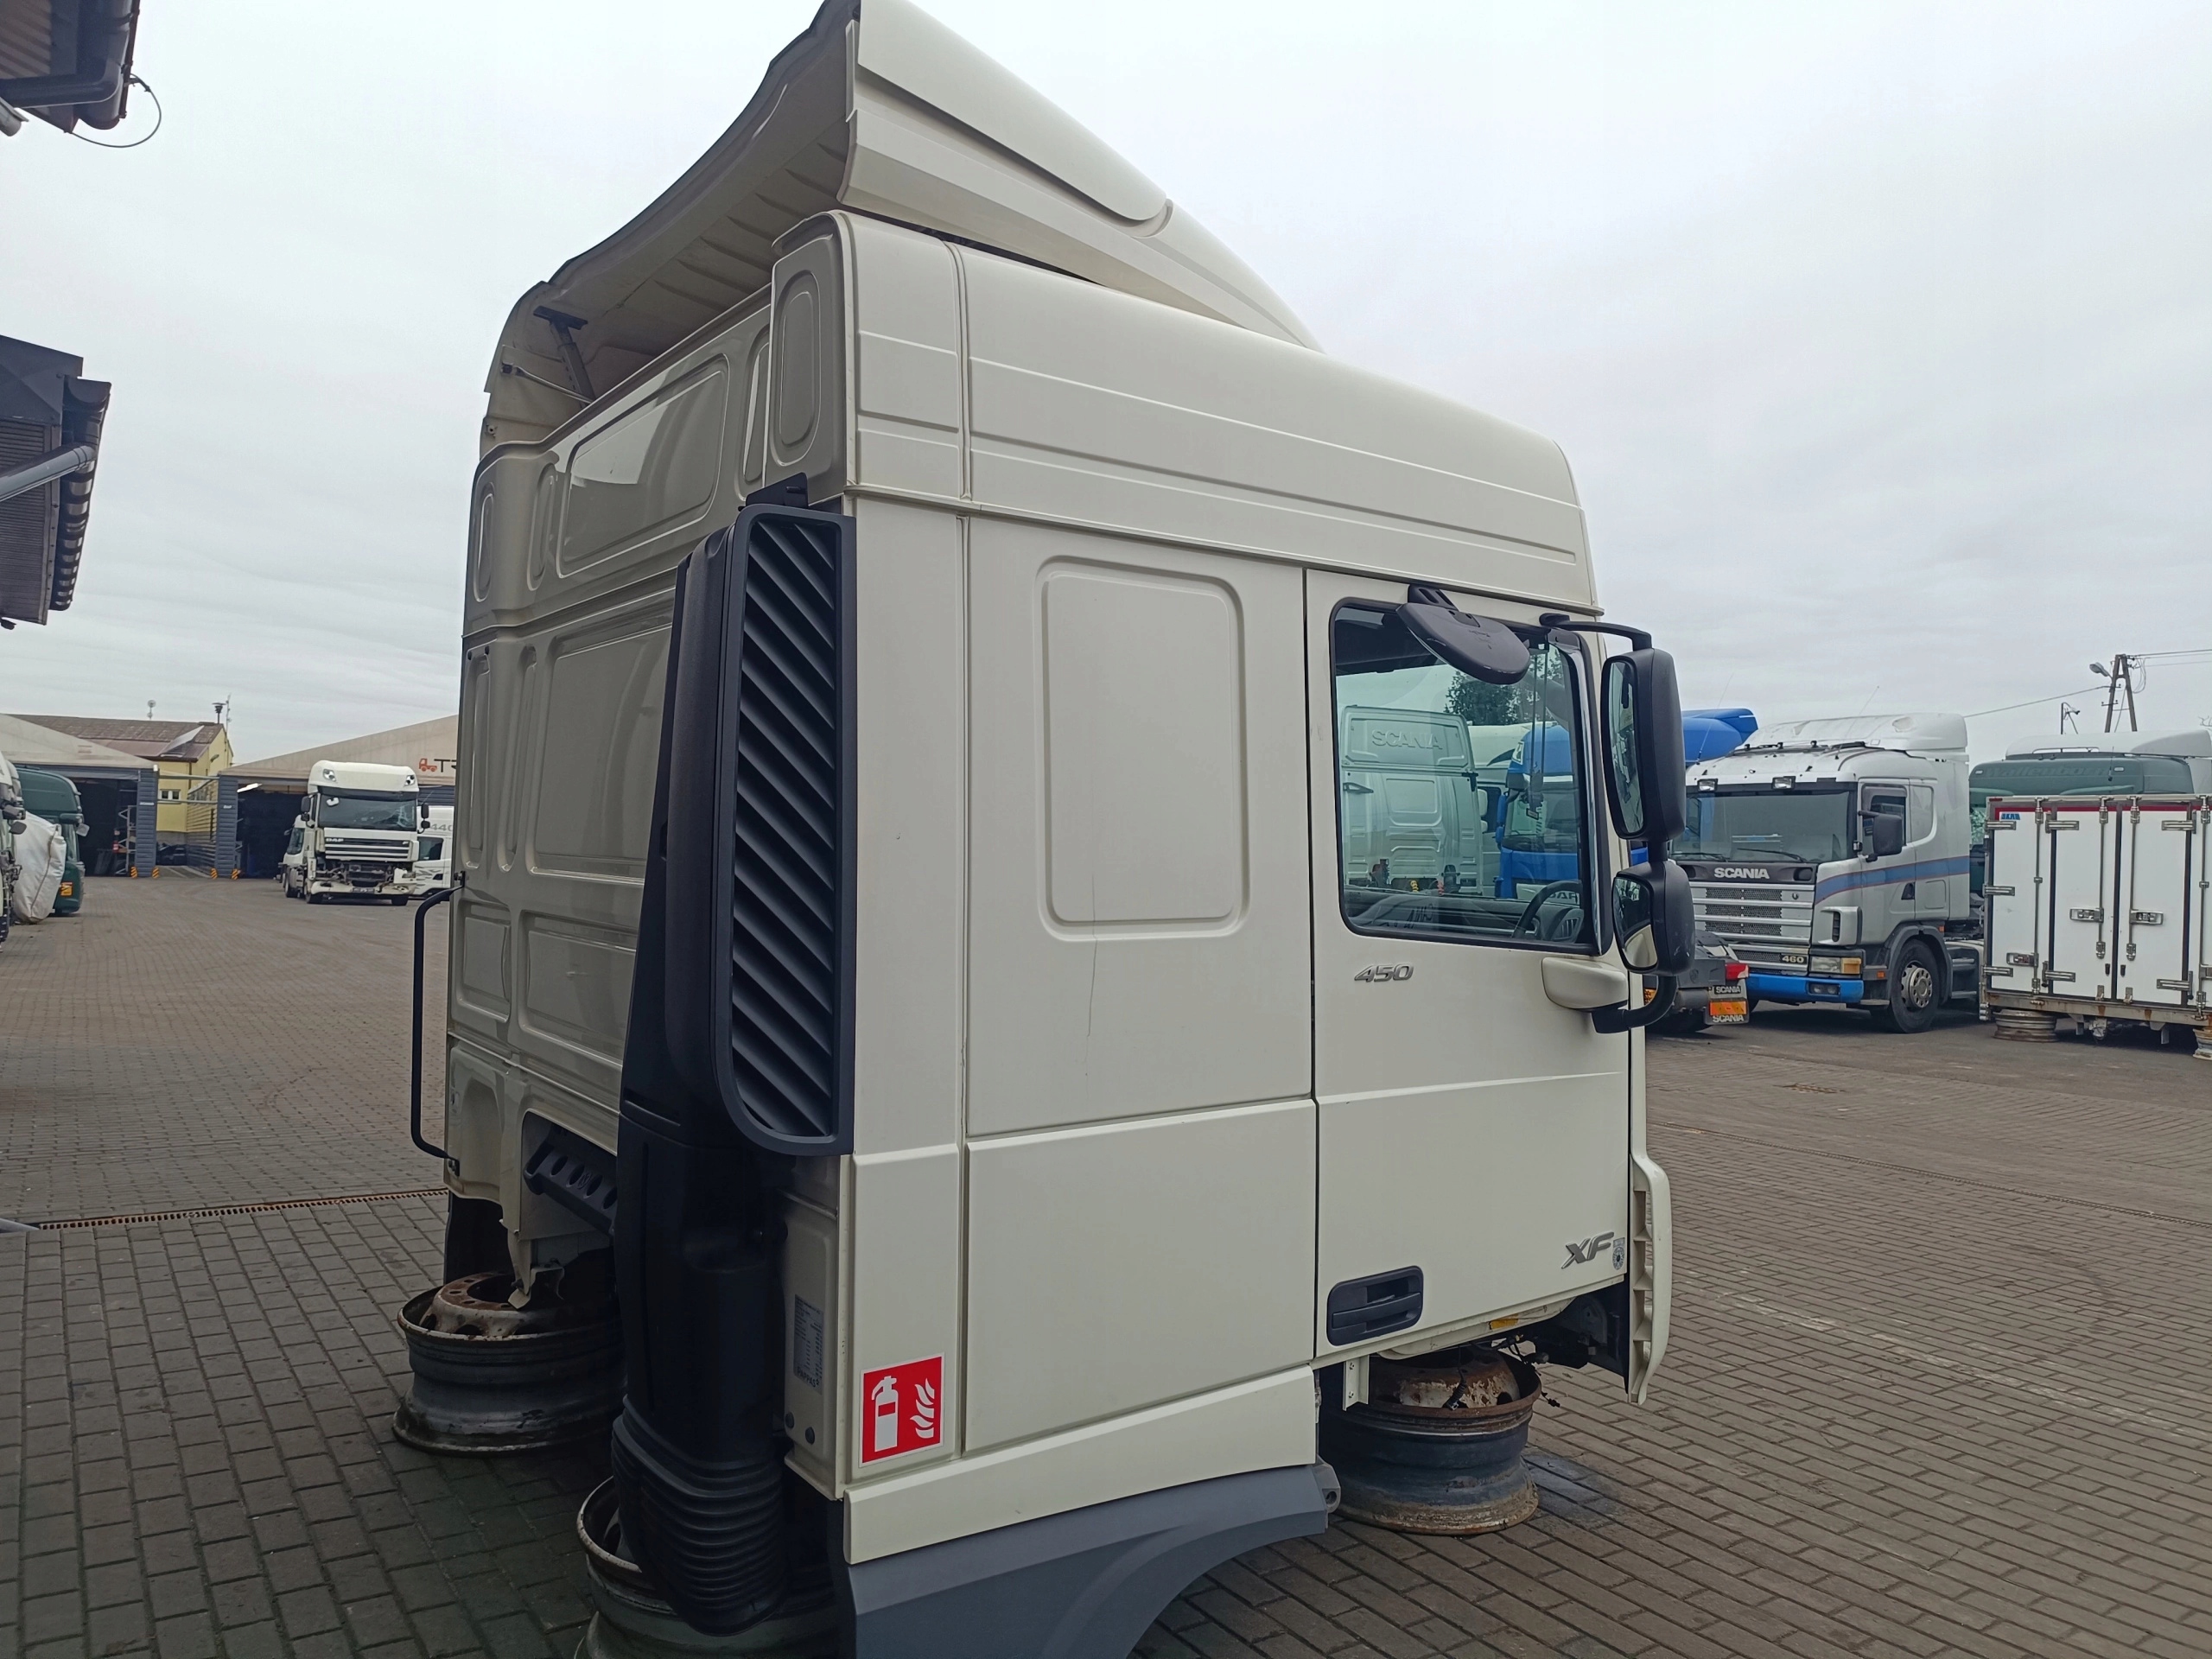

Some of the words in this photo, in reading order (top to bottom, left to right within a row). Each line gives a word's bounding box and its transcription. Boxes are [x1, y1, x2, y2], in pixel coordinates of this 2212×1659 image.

[1372, 730, 1443, 750] SCANIA
[1714, 868, 1770, 879] SCANIA
[1782, 955, 1804, 963] 460
[1354, 963, 1414, 982] 450
[1712, 1014, 1744, 1023] SCANIA
[1561, 1231, 1614, 1269] XF
